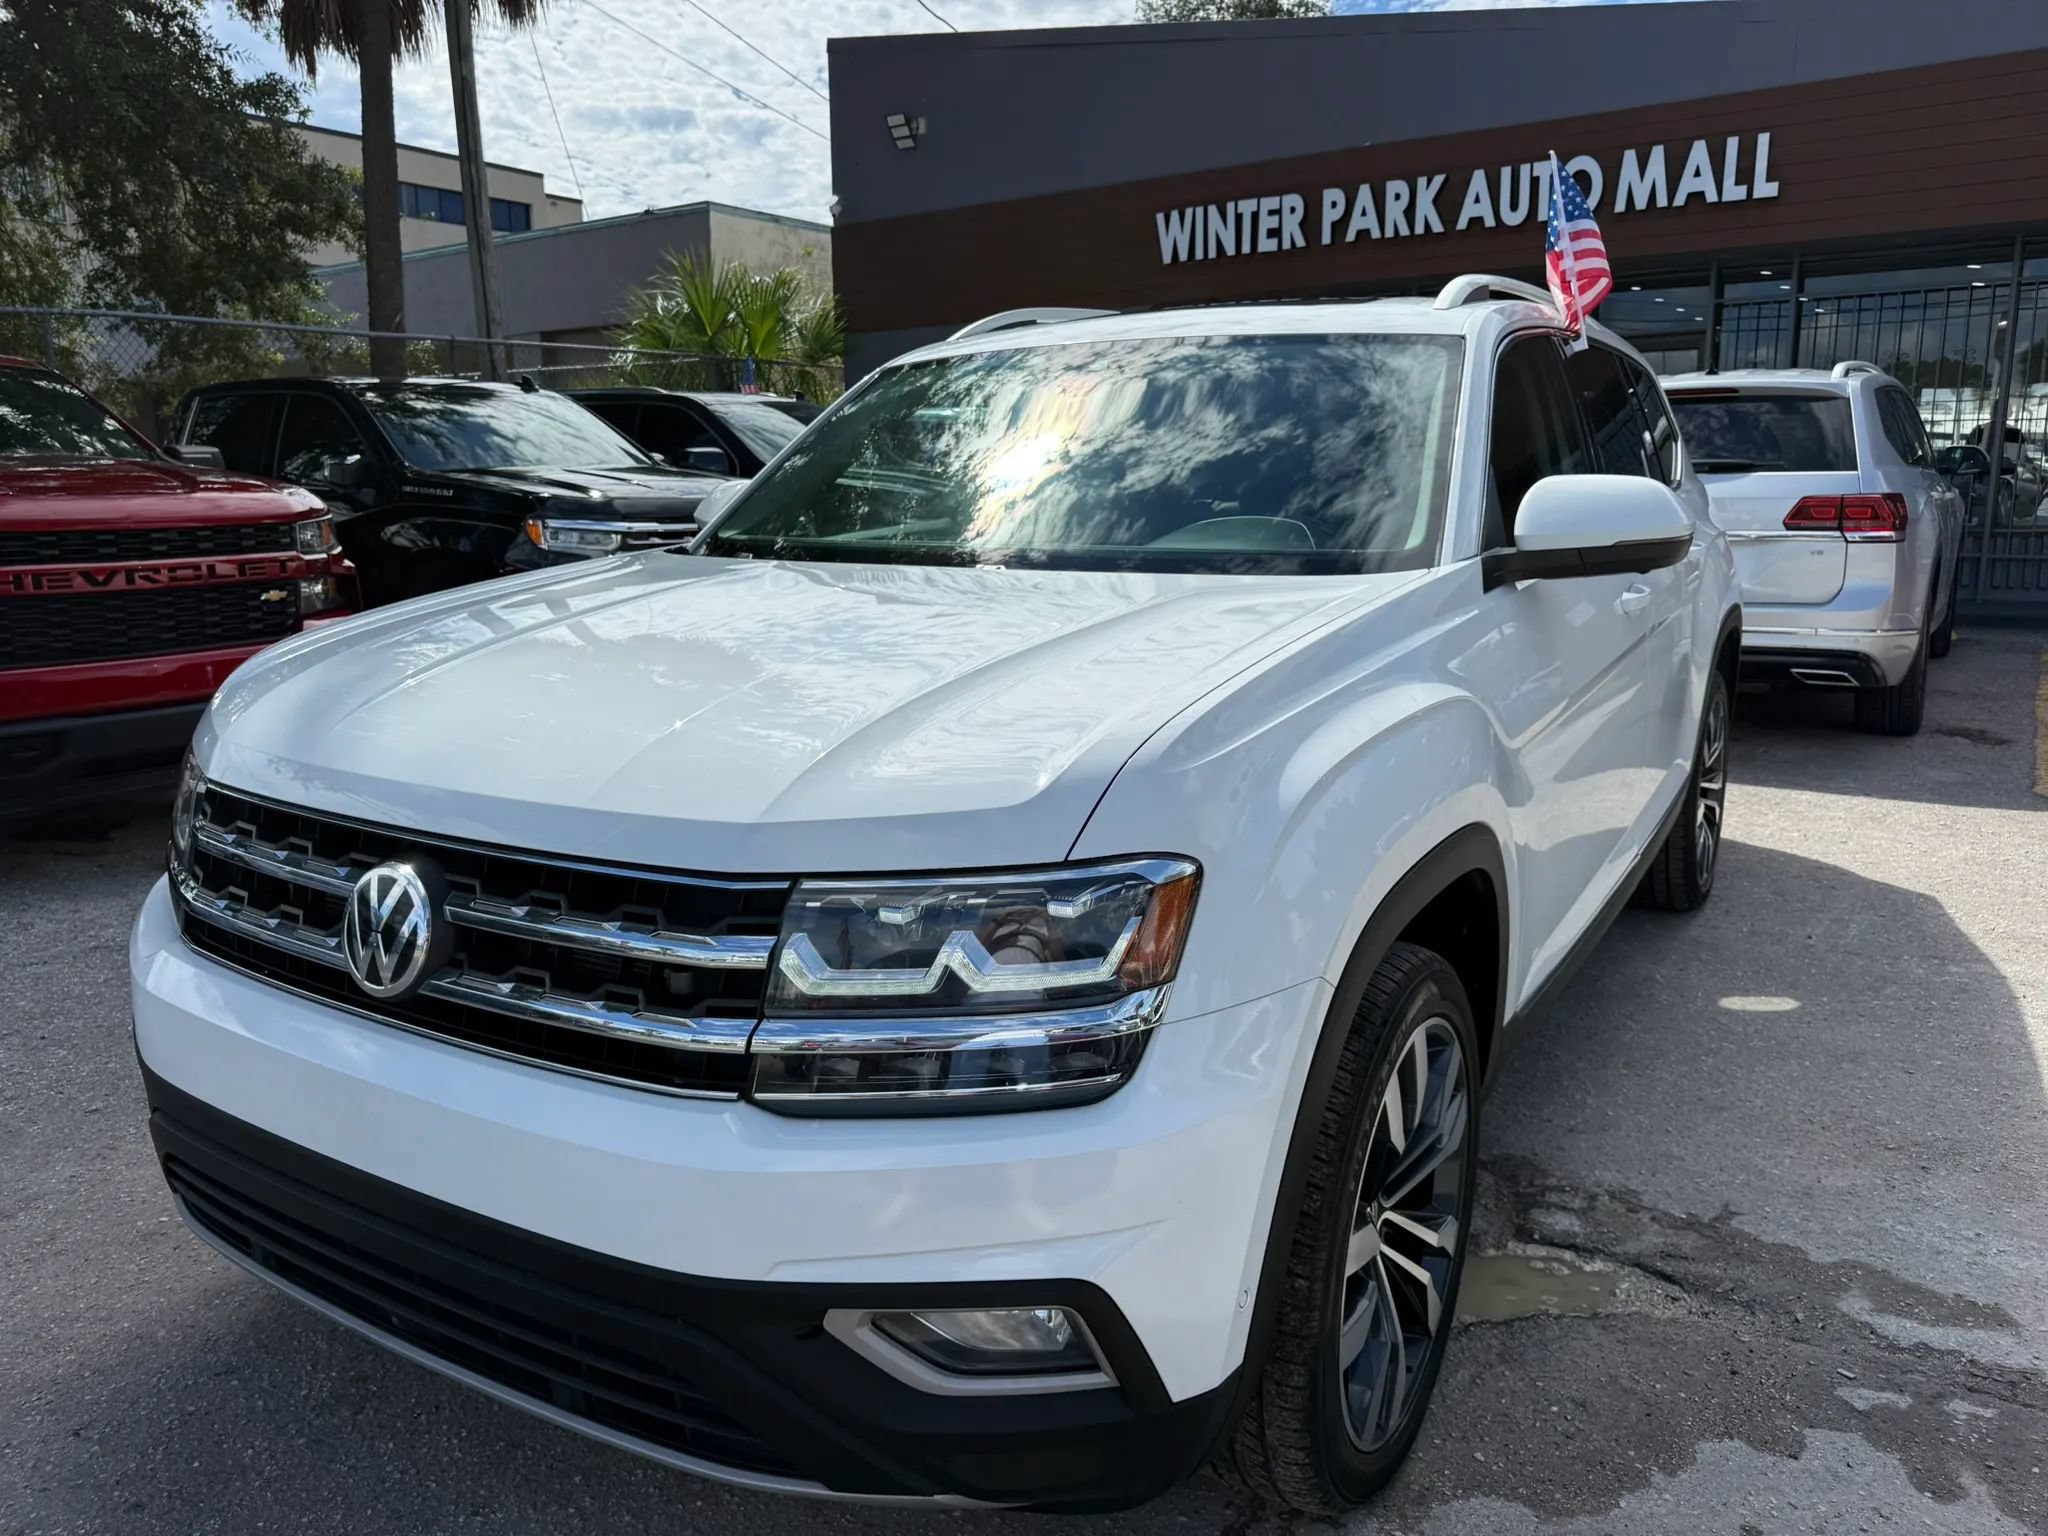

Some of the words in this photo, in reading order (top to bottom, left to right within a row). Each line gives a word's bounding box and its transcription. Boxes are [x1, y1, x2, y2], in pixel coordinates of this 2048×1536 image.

[1155, 193, 1307, 265] WINTER
[1321, 174, 1445, 245] PARK
[1456, 154, 1604, 231] AUTO
[1614, 132, 1779, 214] MALL
[0, 556, 297, 592] HEVROLET
